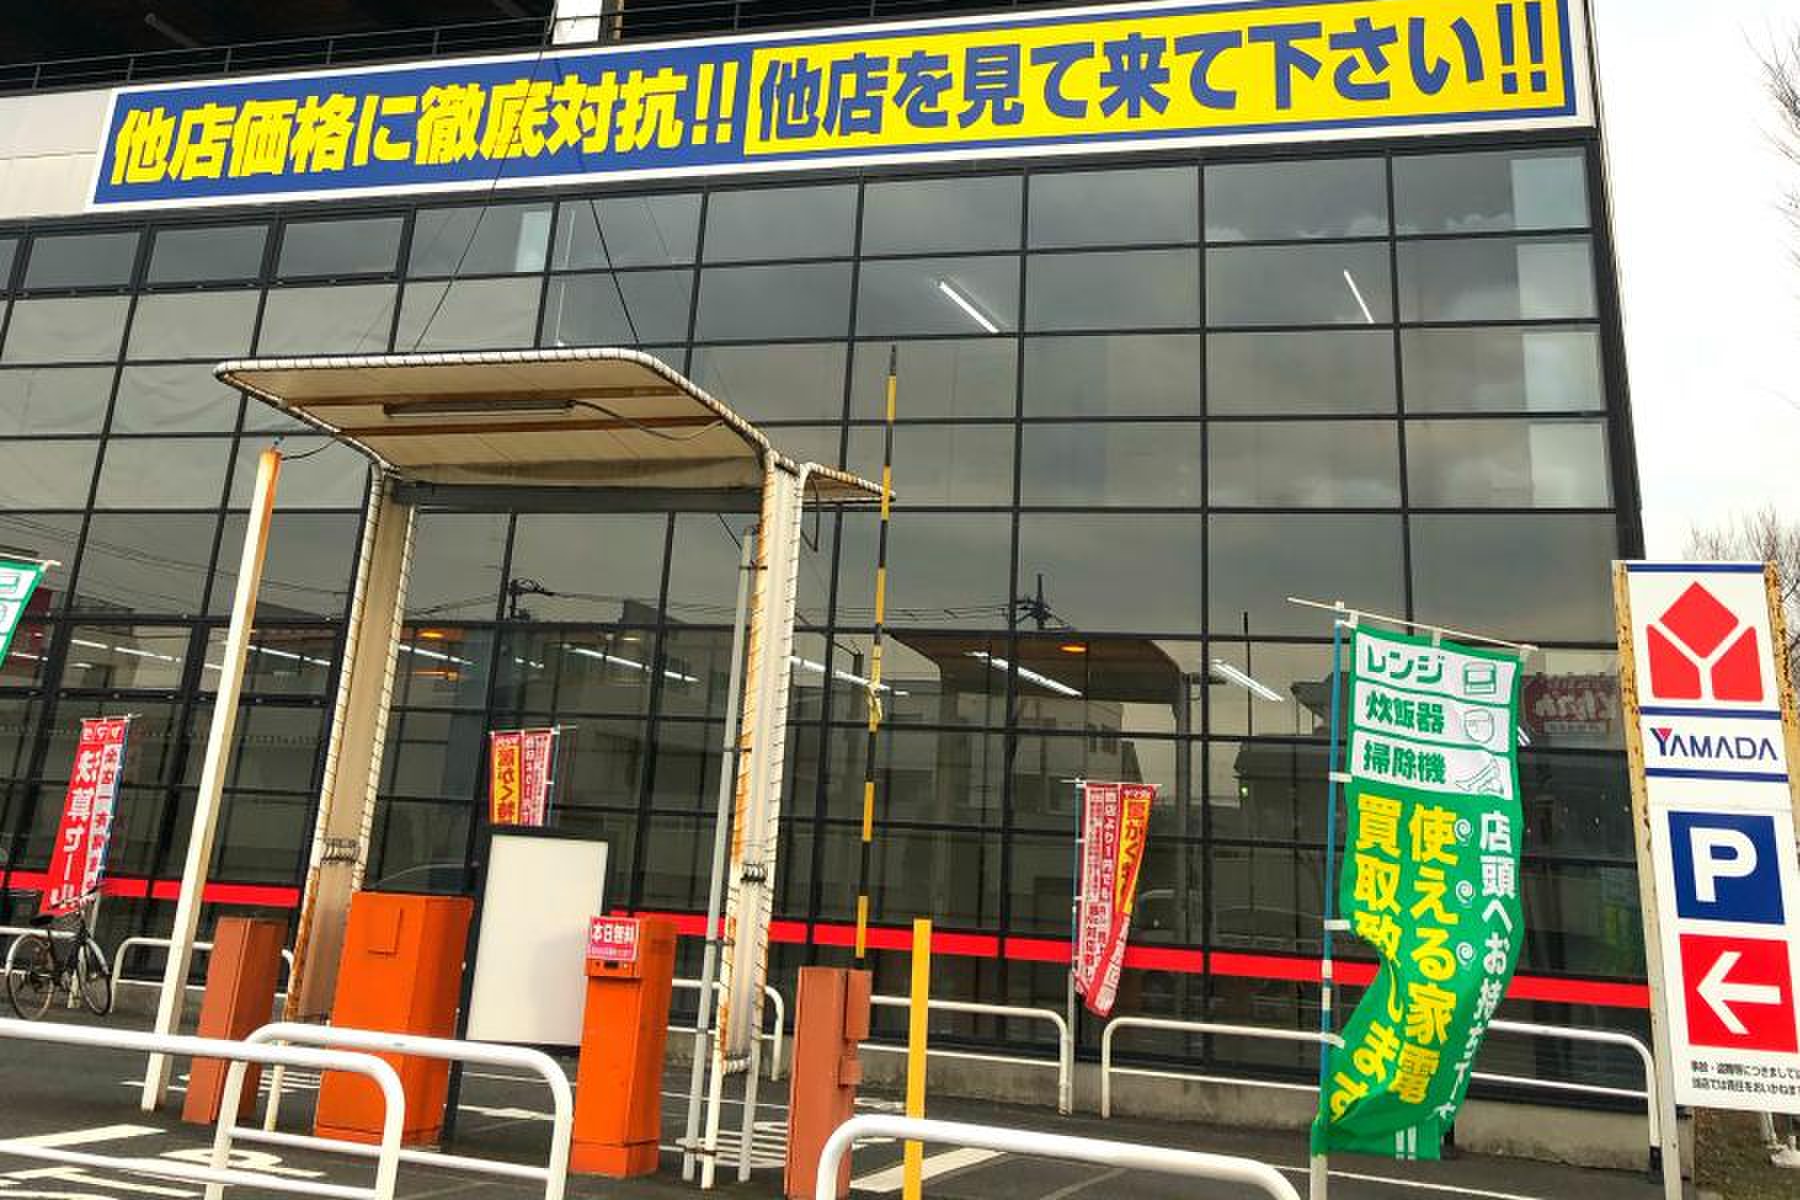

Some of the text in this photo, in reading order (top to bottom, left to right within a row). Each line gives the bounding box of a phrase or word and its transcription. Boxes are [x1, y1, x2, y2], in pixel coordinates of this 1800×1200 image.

[1367, 644, 1445, 684] レンジ
[1365, 689, 1445, 734] 炊飯器
[1363, 740, 1447, 785] 掃除機
[1650, 727, 1778, 761] YAMADA
[1689, 826, 1758, 902] P
